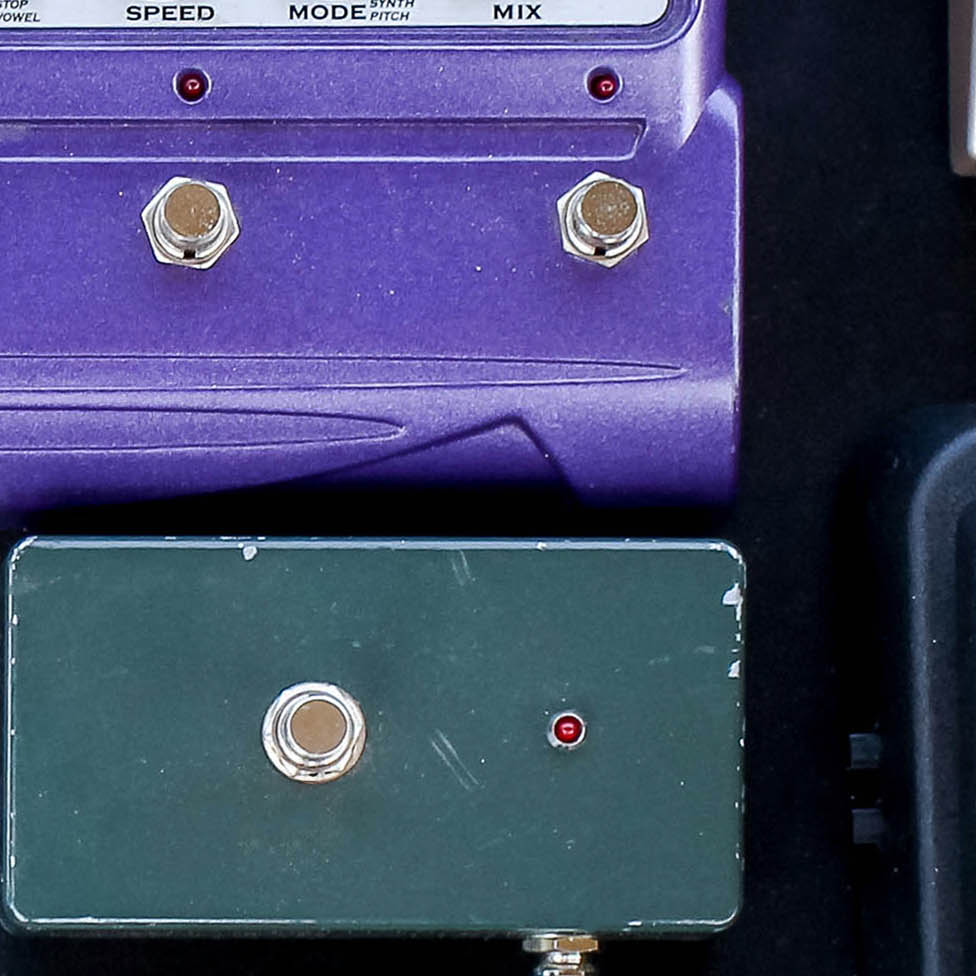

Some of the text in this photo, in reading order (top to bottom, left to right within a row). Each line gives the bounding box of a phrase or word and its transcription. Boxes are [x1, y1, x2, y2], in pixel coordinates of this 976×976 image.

[370, 0, 414, 8] SYNTH
[126, 6, 215, 21] SPEED
[289, 5, 366, 20] MODE
[369, 10, 410, 21] PITCH
[493, 5, 542, 20] MIX
